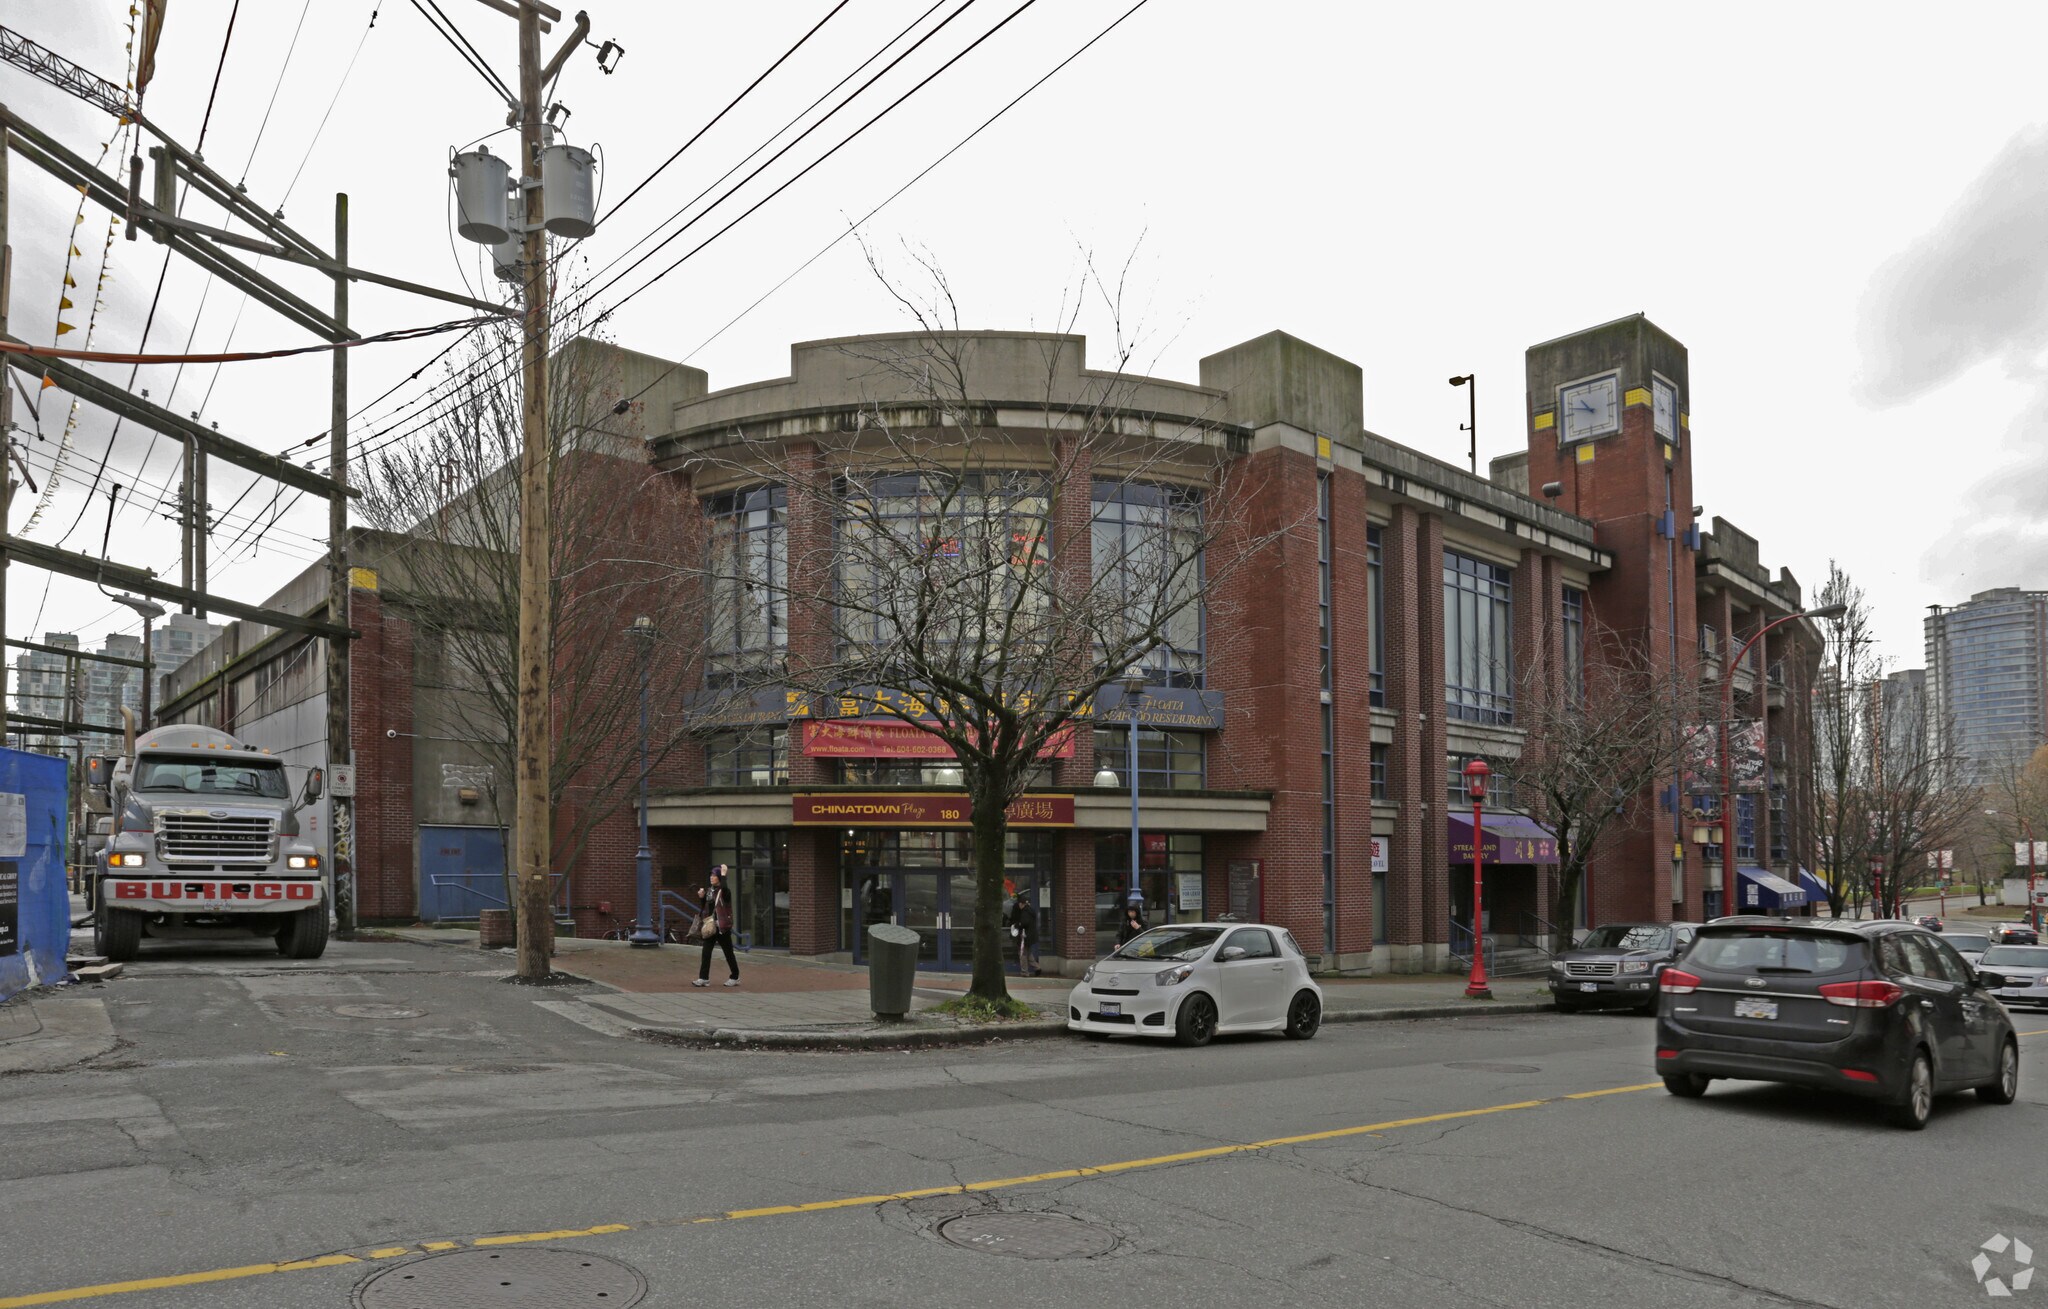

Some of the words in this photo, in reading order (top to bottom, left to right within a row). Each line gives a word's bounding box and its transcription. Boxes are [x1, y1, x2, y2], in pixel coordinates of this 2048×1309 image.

[1152, 713, 1216, 726] RESTAURANT
[889, 727, 927, 739] FLOATA
[810, 745, 866, 753] www.floata.com
[883, 746, 896, 754] Tel:
[896, 746, 947, 754] 604-602-0368
[811, 805, 900, 814] CHINATOWN
[940, 809, 960, 820] 180
[1453, 844, 1497, 852] STREAAND
[115, 882, 314, 900] BURNCO
